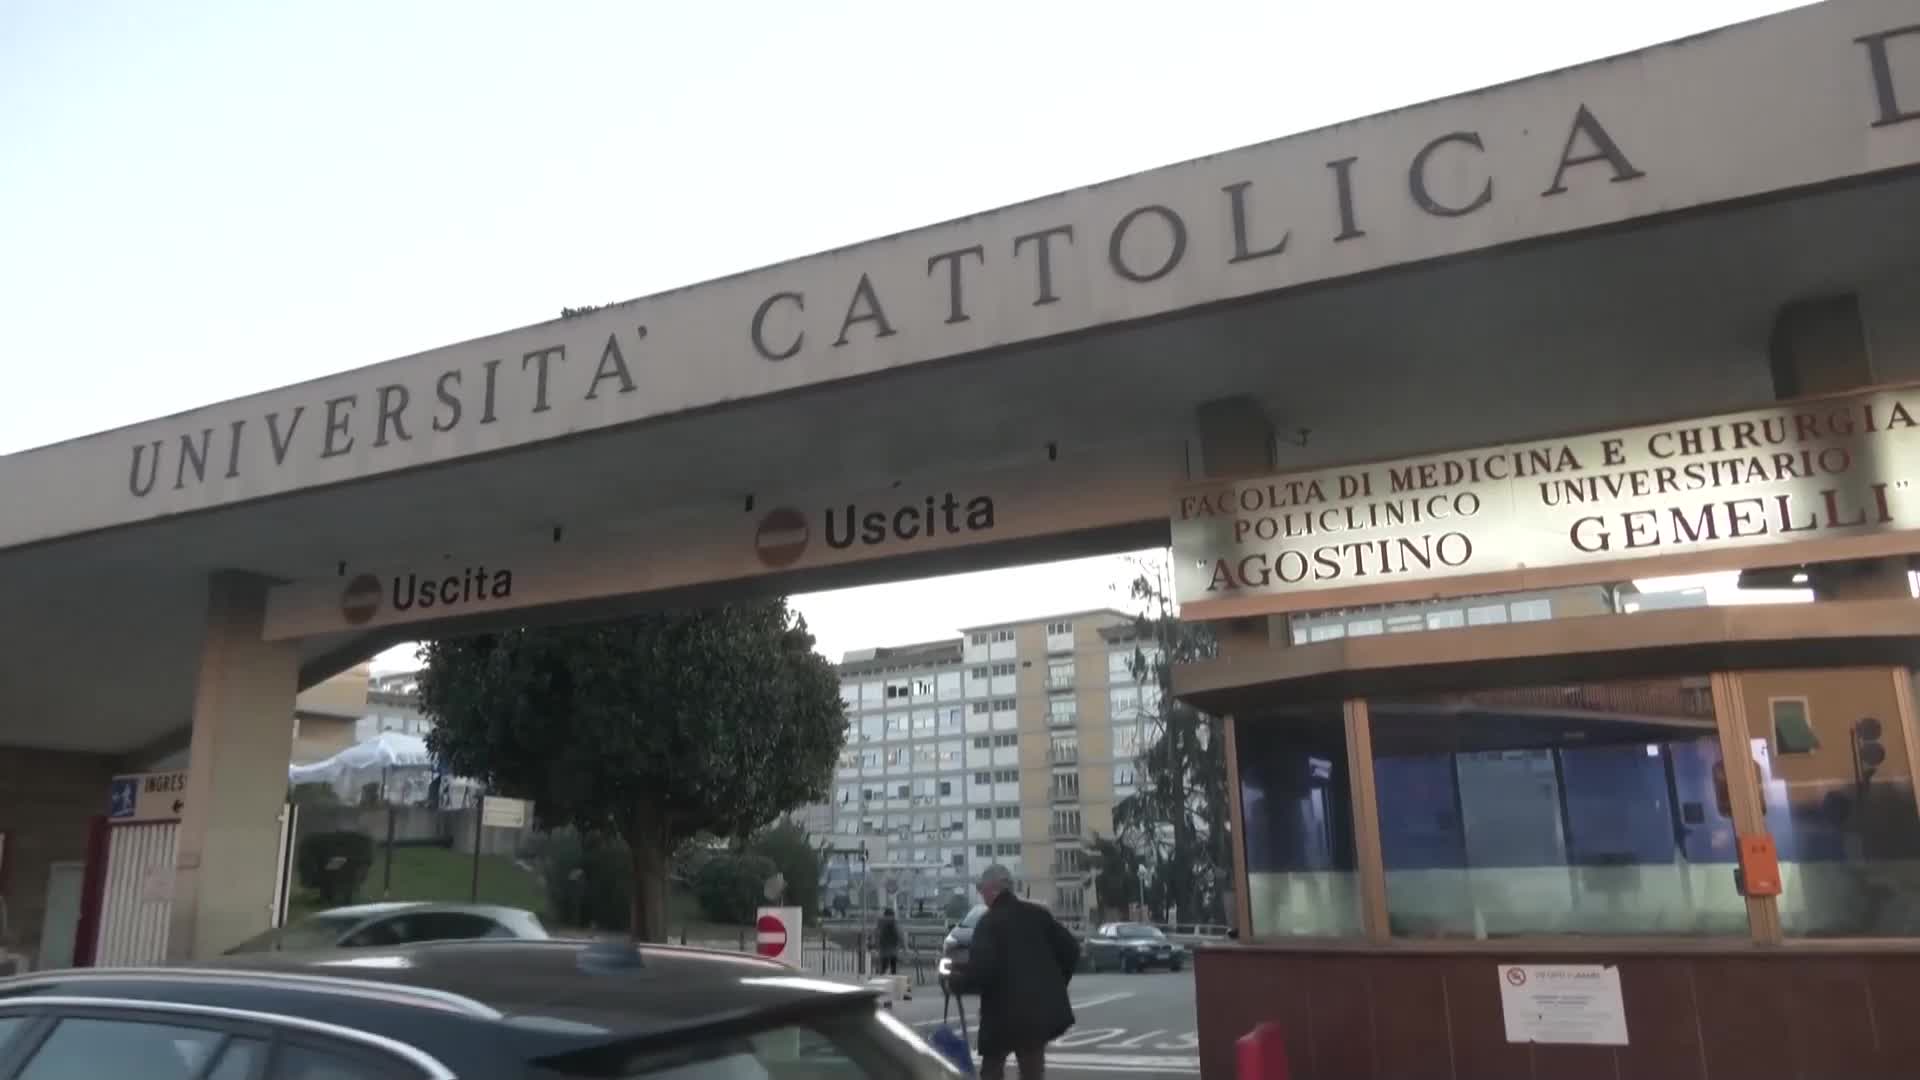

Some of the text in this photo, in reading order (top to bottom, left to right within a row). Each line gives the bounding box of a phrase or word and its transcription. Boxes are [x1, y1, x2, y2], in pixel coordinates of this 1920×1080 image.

[750, 103, 1646, 361] CATTOLICA
[1338, 472, 1372, 500] DI
[1389, 444, 1582, 494] MEDICINA
[1601, 438, 1626, 466] E
[1647, 400, 1917, 460] CHIRURGIA
[824, 492, 994, 549] Uscita
[1234, 446, 1851, 544] POLICLINICO UNIVERSITARIO
[392, 565, 513, 611] Uscita
[144, 773, 188, 793] INGRES
